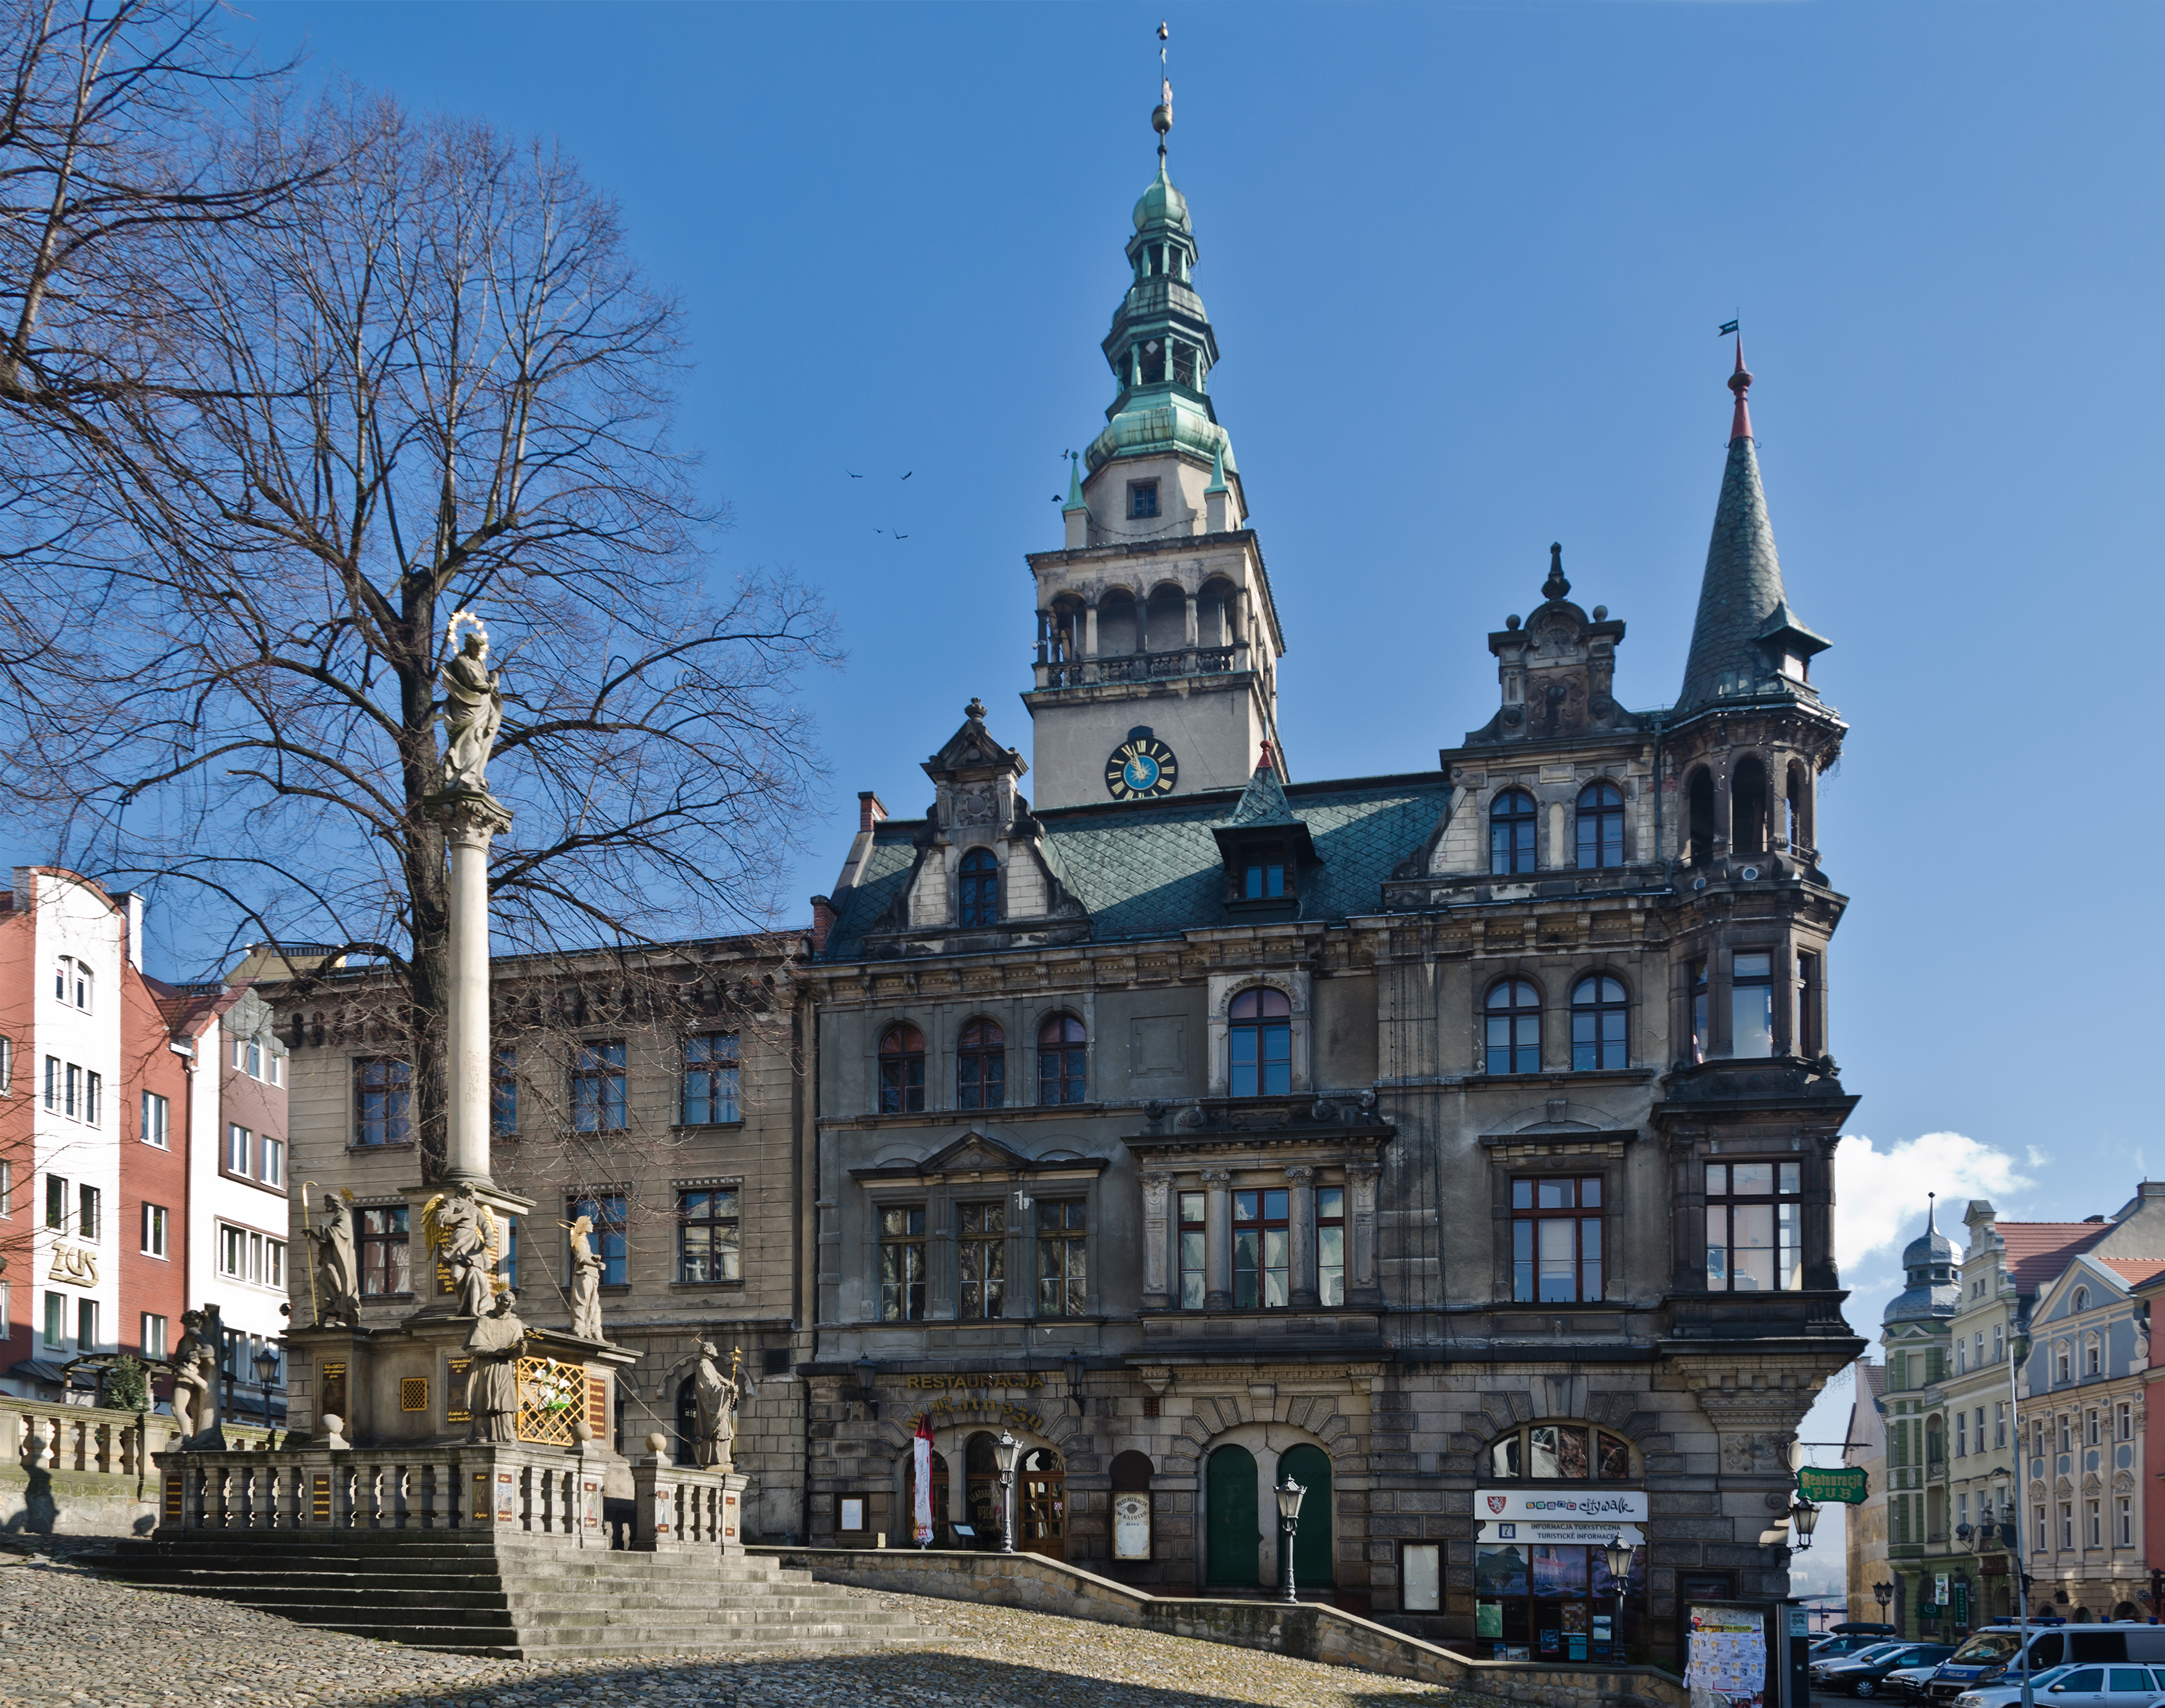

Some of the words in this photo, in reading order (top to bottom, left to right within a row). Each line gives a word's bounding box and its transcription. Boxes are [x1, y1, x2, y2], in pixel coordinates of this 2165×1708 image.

[49, 1242, 99, 1288] ZUS
[907, 1374, 1045, 1389] RESTAURACJA
[931, 1395, 1043, 1429] Ratuszu
[1801, 1471, 1862, 1489] Restauracja
[1812, 1487, 1852, 1499] PUB
[1116, 1497, 1147, 1507] RESTAURACJA
[1123, 1511, 1147, 1520] RATUSZU
